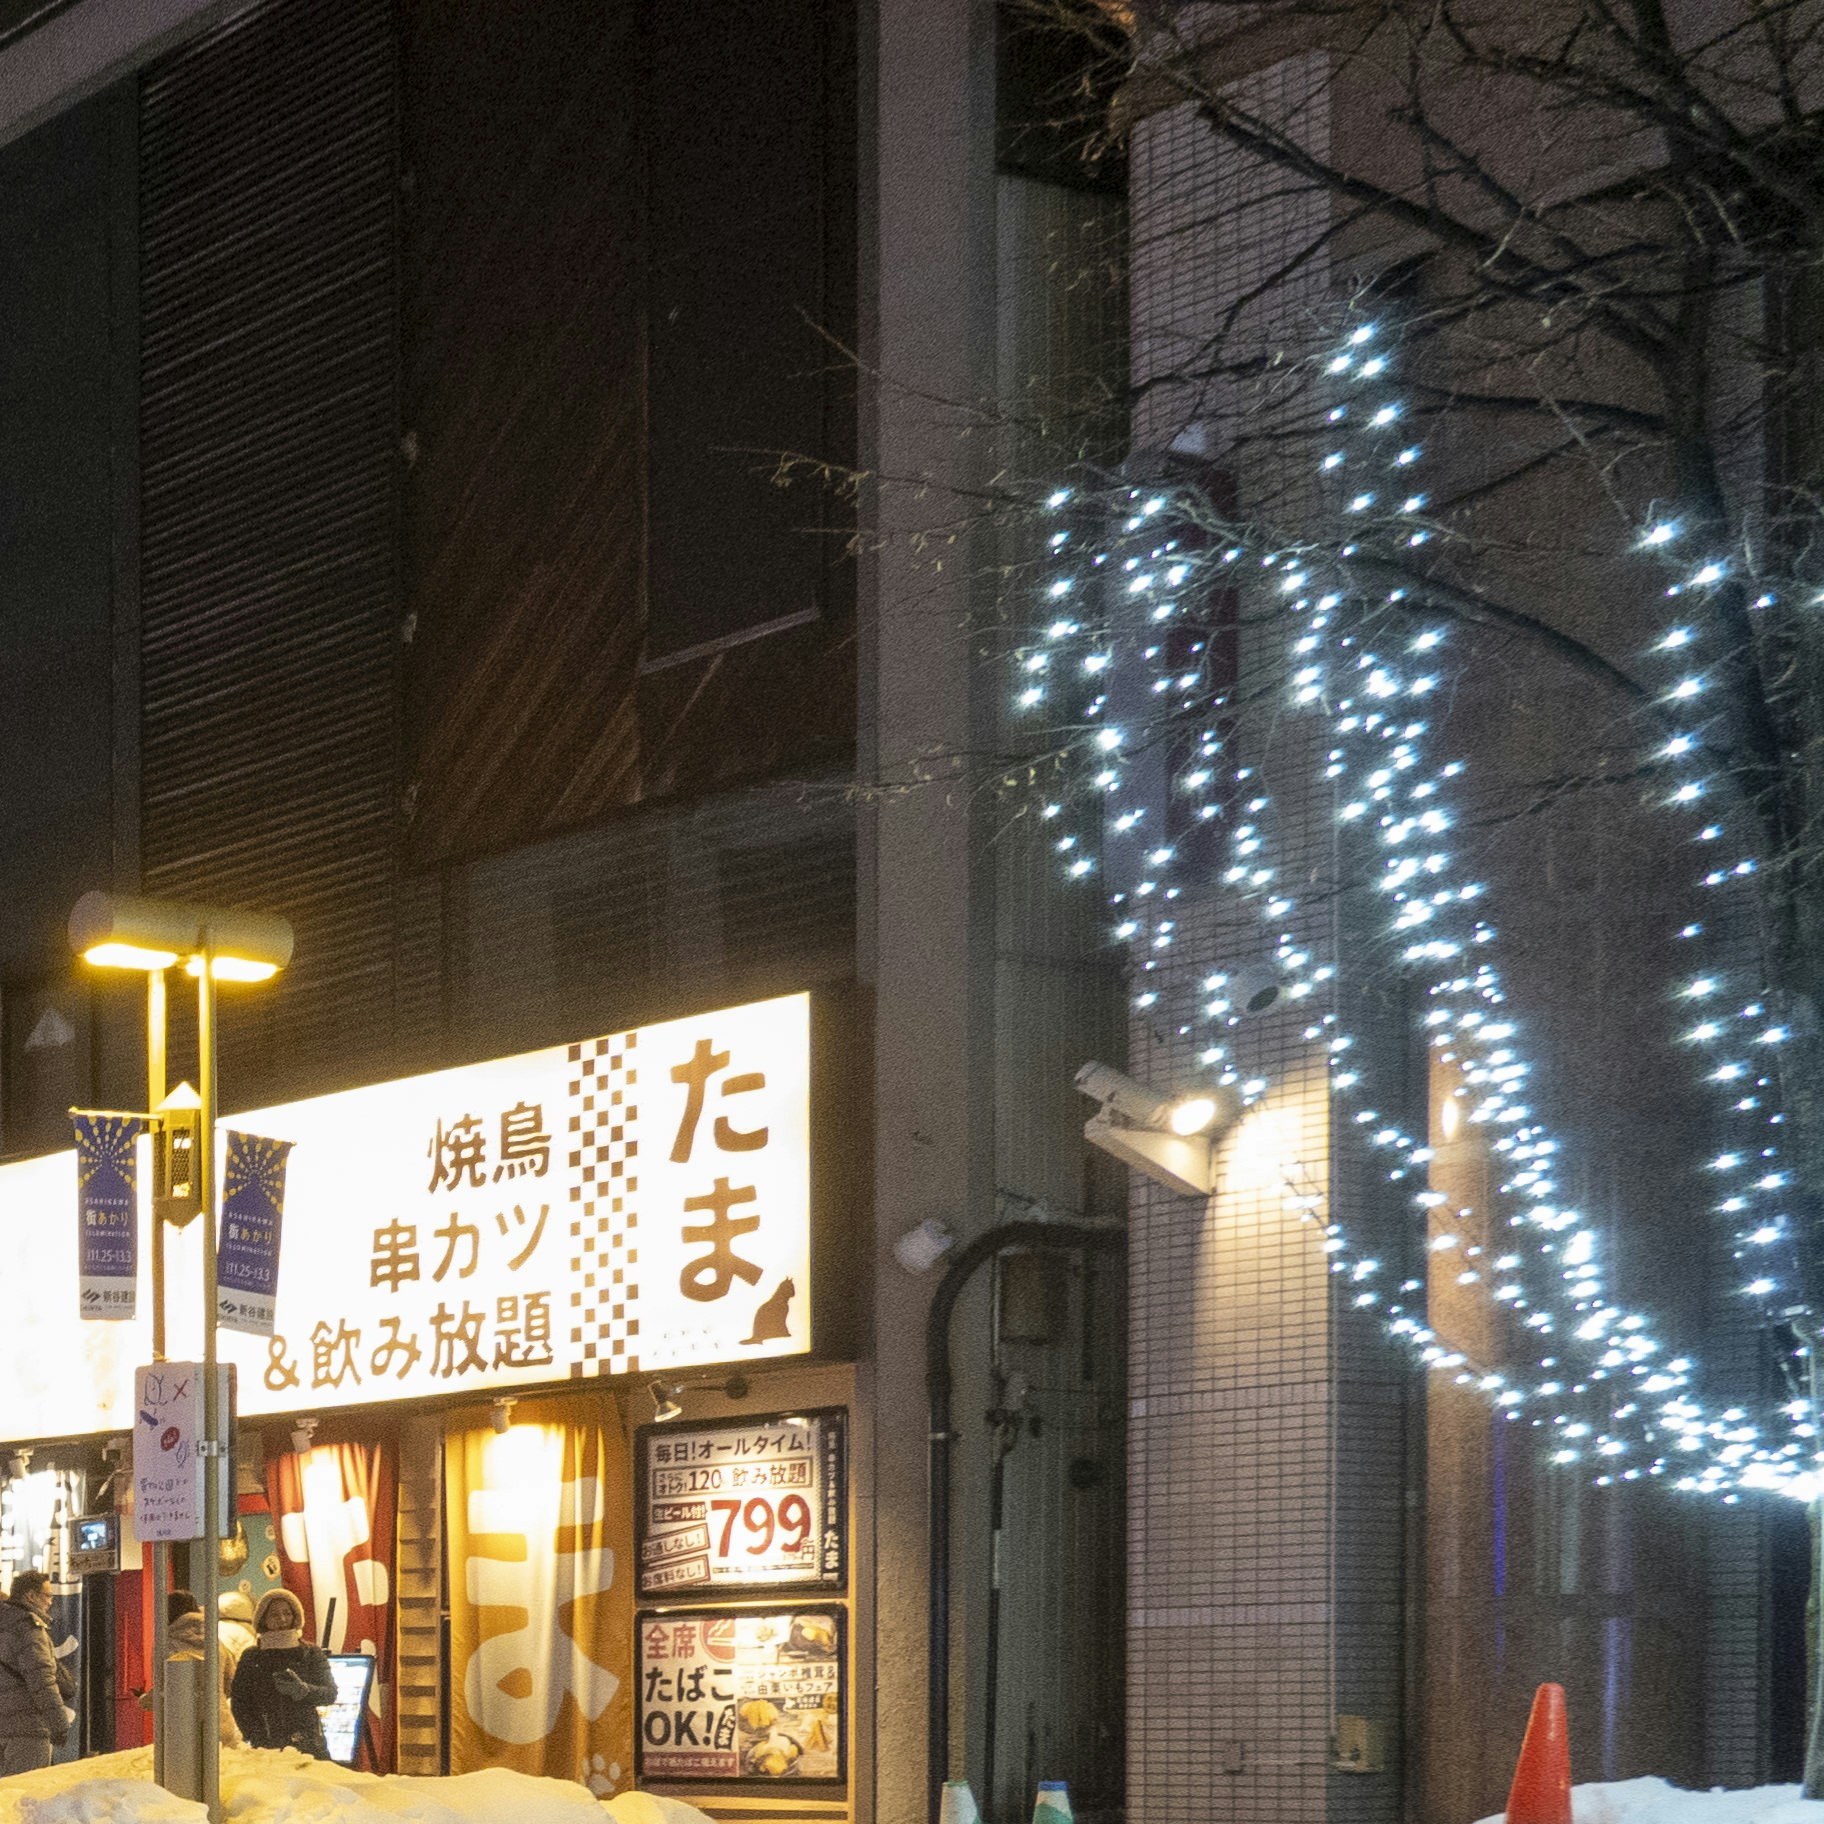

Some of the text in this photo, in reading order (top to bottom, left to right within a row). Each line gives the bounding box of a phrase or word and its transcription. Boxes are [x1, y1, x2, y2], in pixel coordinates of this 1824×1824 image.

[427, 1101, 552, 1196] 焼鳥
[669, 1038, 770, 1303] たま
[370, 1203, 552, 1294] 串カツ
[264, 1290, 556, 1392] &飲み放題
[710, 1493, 811, 1558] 799
[465, 1476, 620, 1745] ま
[644, 1624, 697, 1660] 全席
[644, 1710, 715, 1746] OK!
[645, 1665, 734, 1702] たばこ
